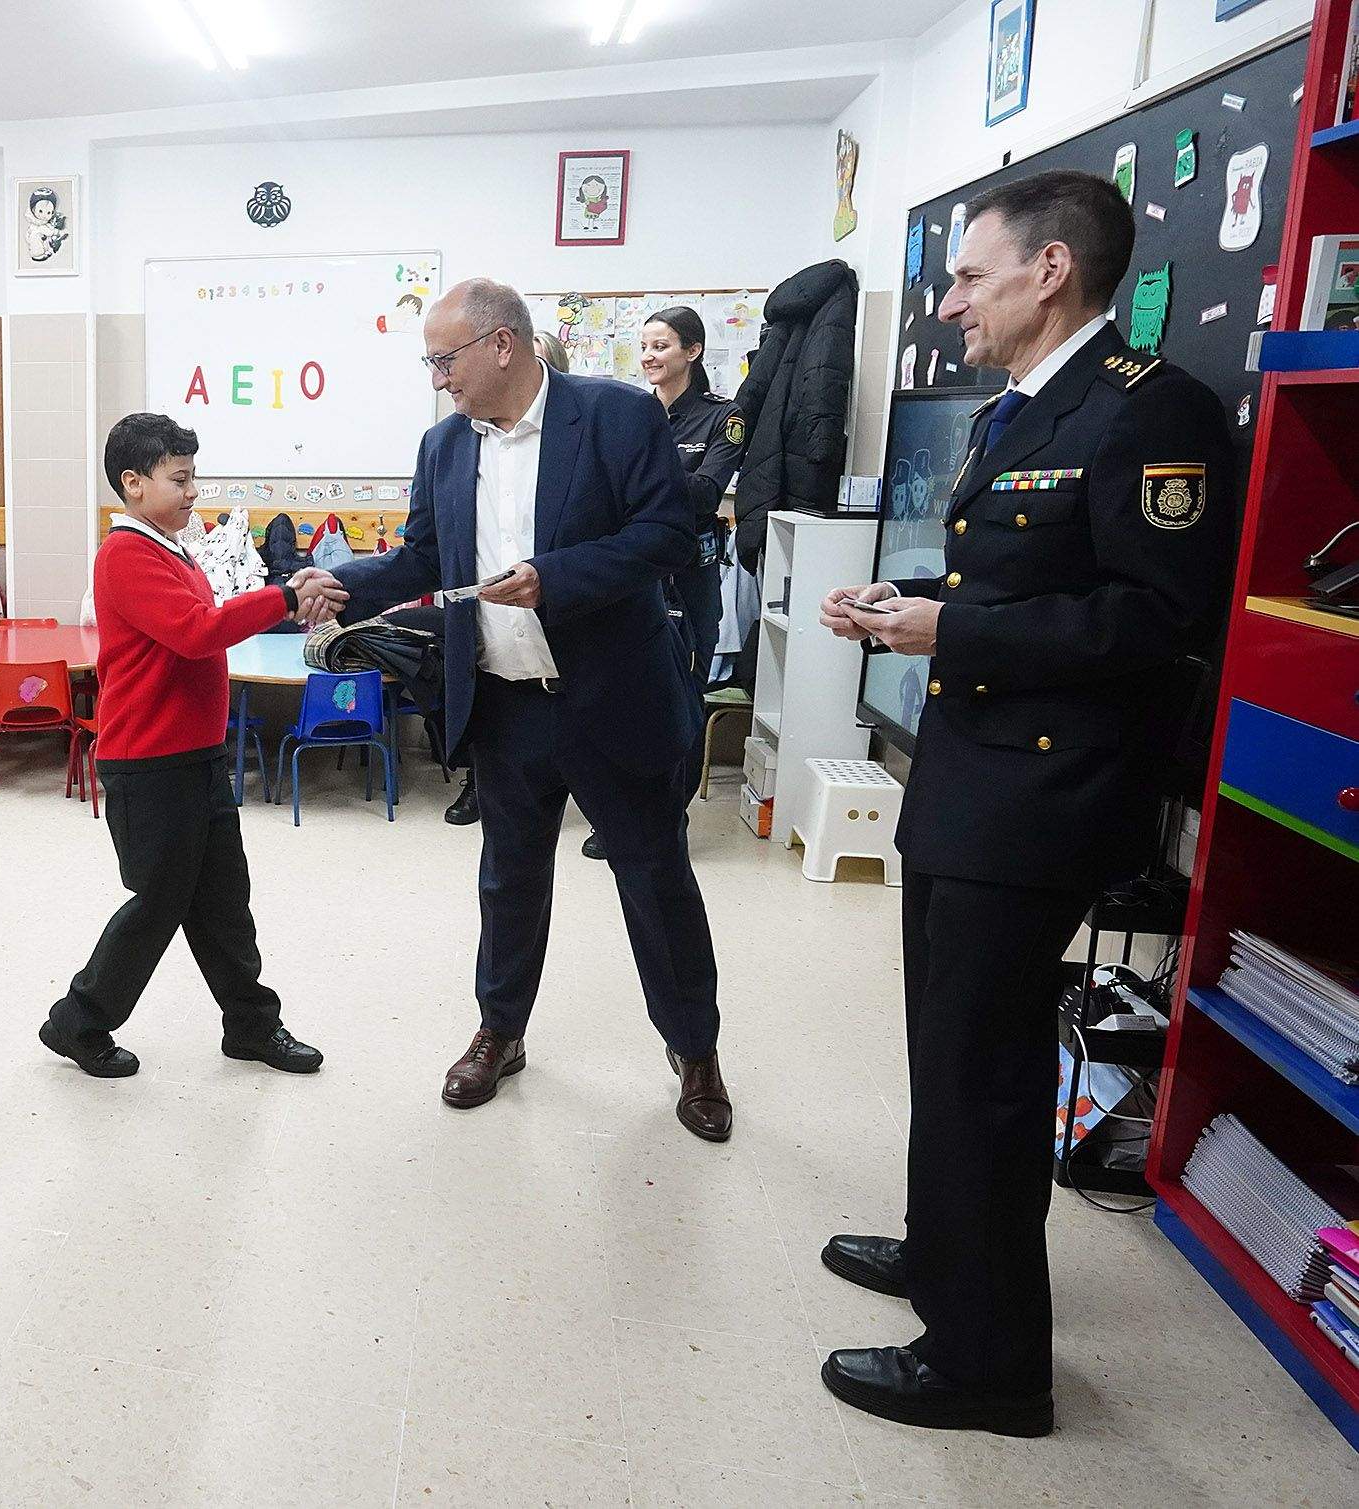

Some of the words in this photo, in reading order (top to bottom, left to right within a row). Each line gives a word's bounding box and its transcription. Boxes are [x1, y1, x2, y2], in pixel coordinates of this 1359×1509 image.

[216, 285, 225, 297] 2
[228, 286, 237, 297] 3
[257, 286, 266, 299] 5
[285, 282, 294, 295] 7
[302, 281, 310, 293] 8
[316, 282, 325, 294] 9
[184, 365, 210, 405] A
[232, 365, 254, 405] E
[272, 369, 284, 409] I
[300, 361, 325, 400] O
